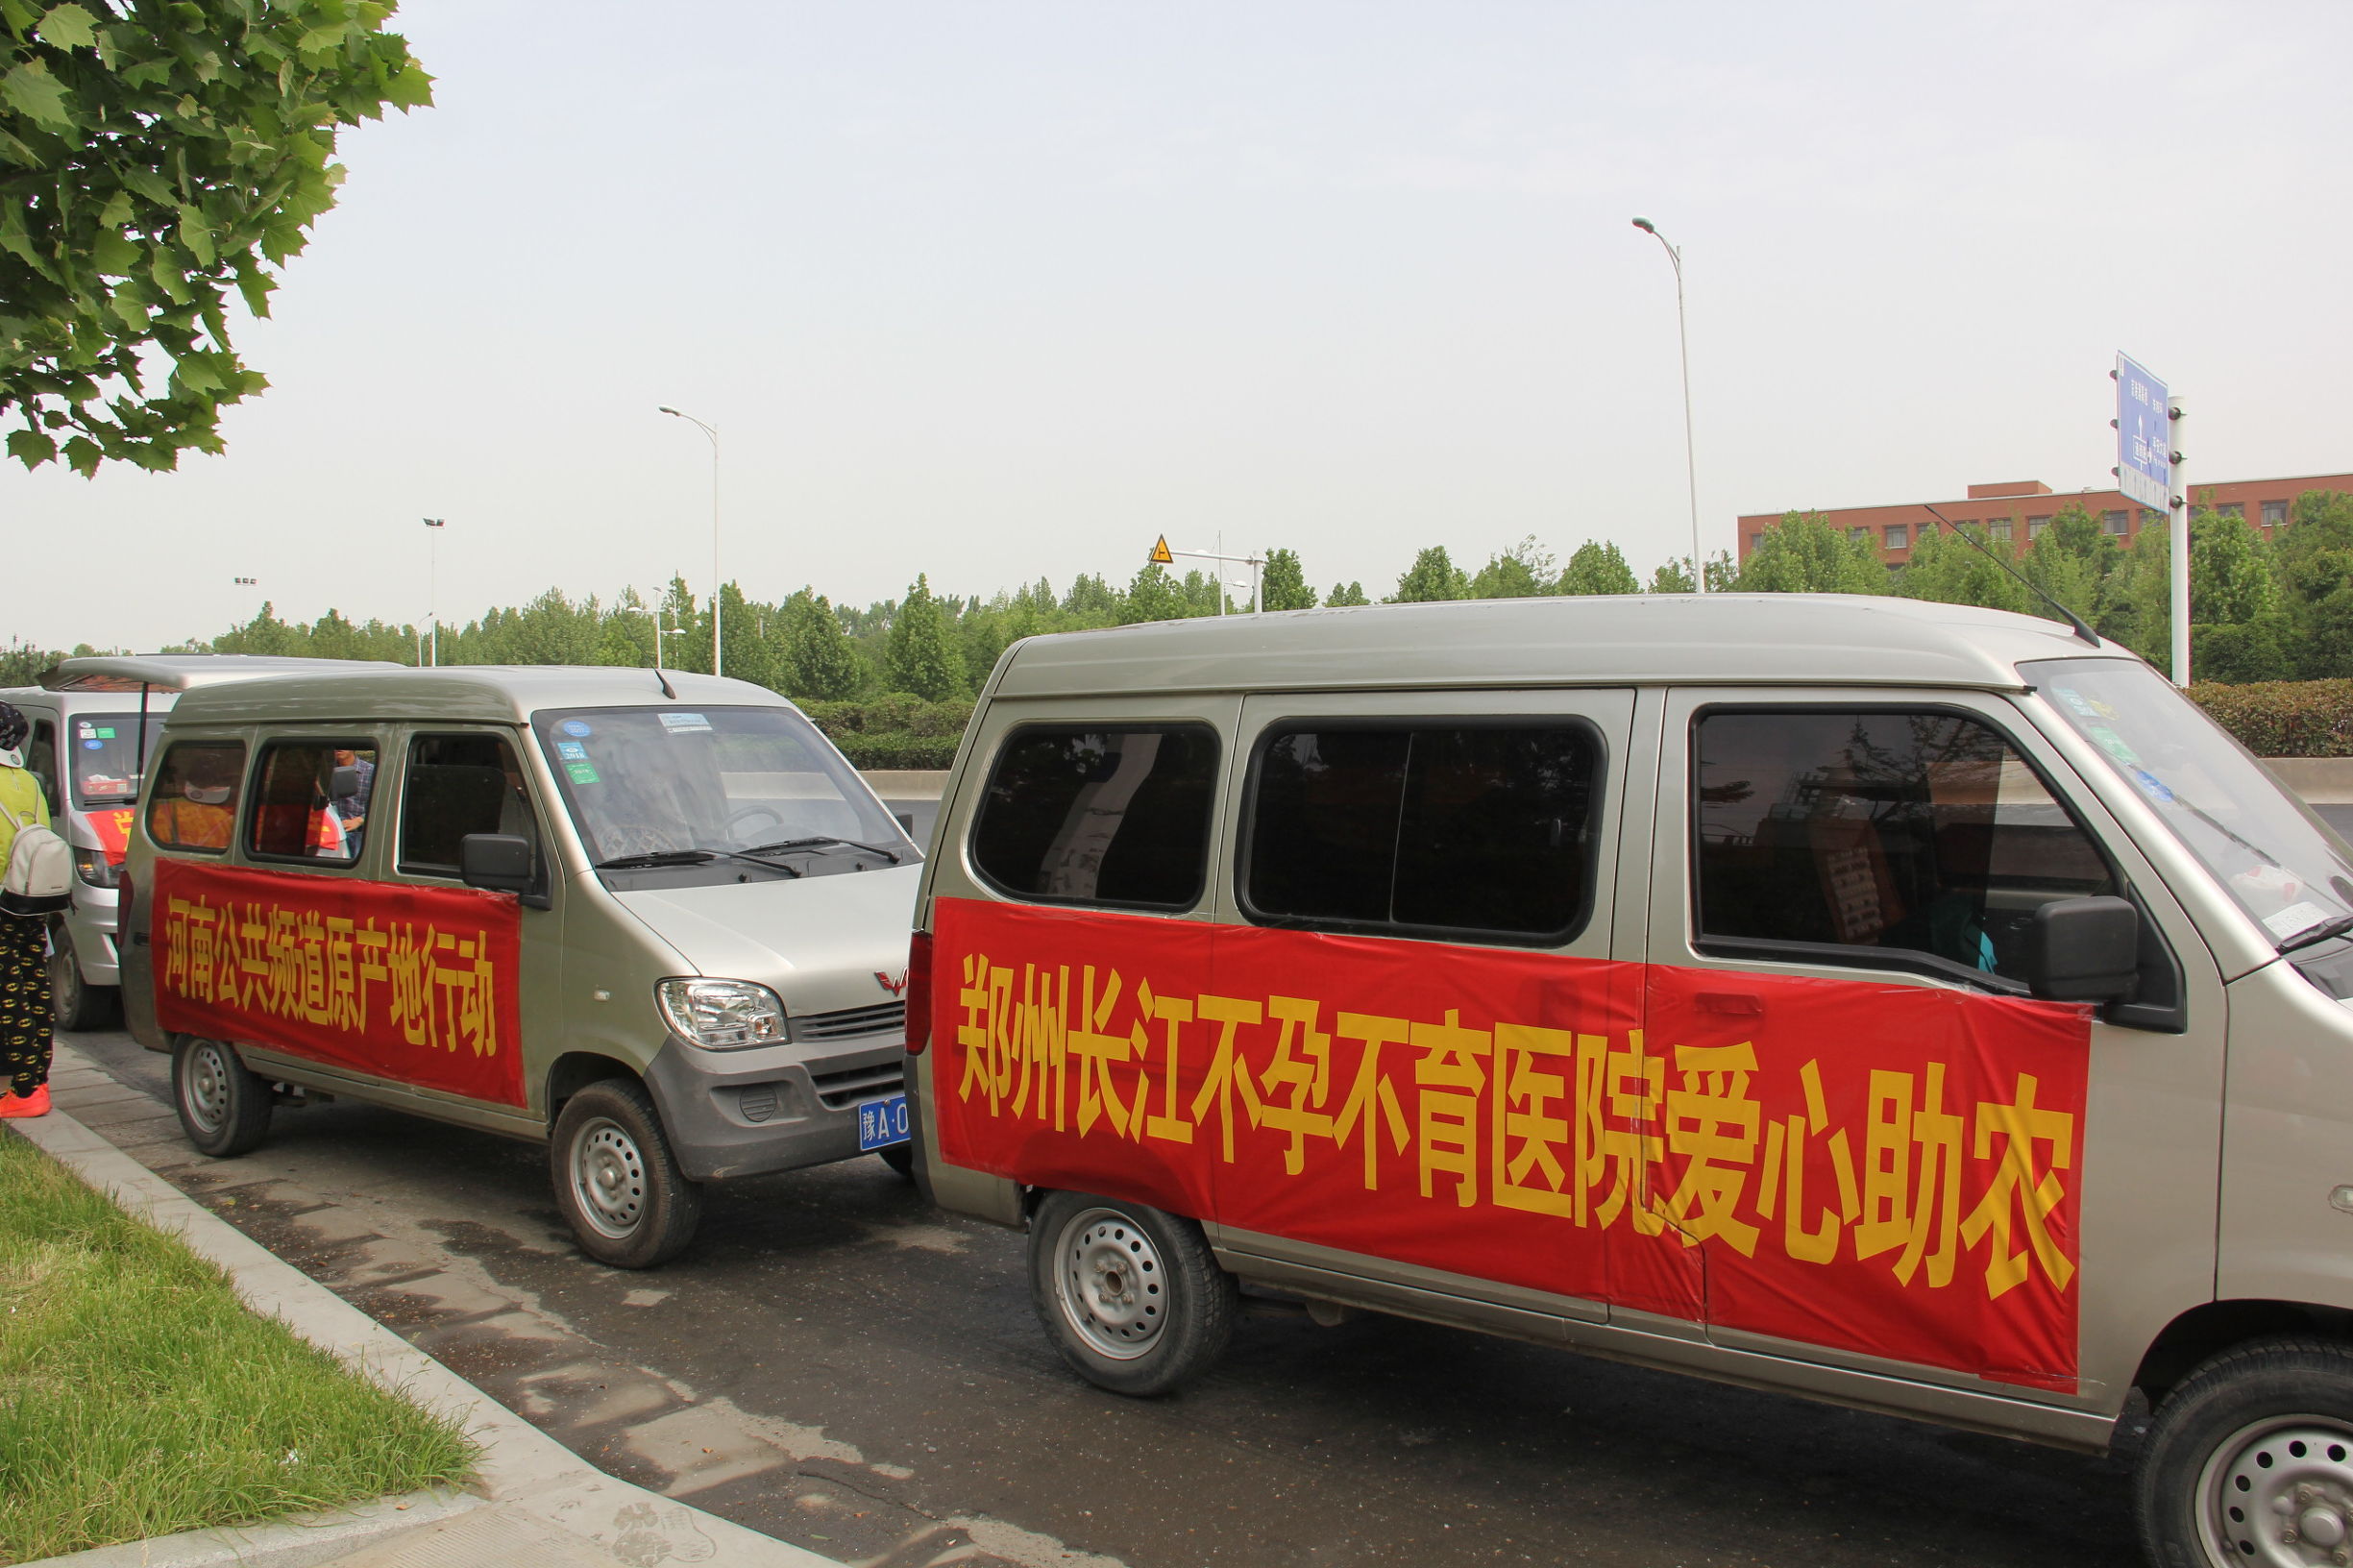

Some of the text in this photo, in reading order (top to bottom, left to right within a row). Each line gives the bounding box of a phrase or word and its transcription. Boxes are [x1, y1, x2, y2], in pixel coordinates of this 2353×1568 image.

[165, 893, 496, 1057] 河南公共频道原产地行动
[957, 953, 2076, 1300] 郑州长江不孕不育医院爱心助农
